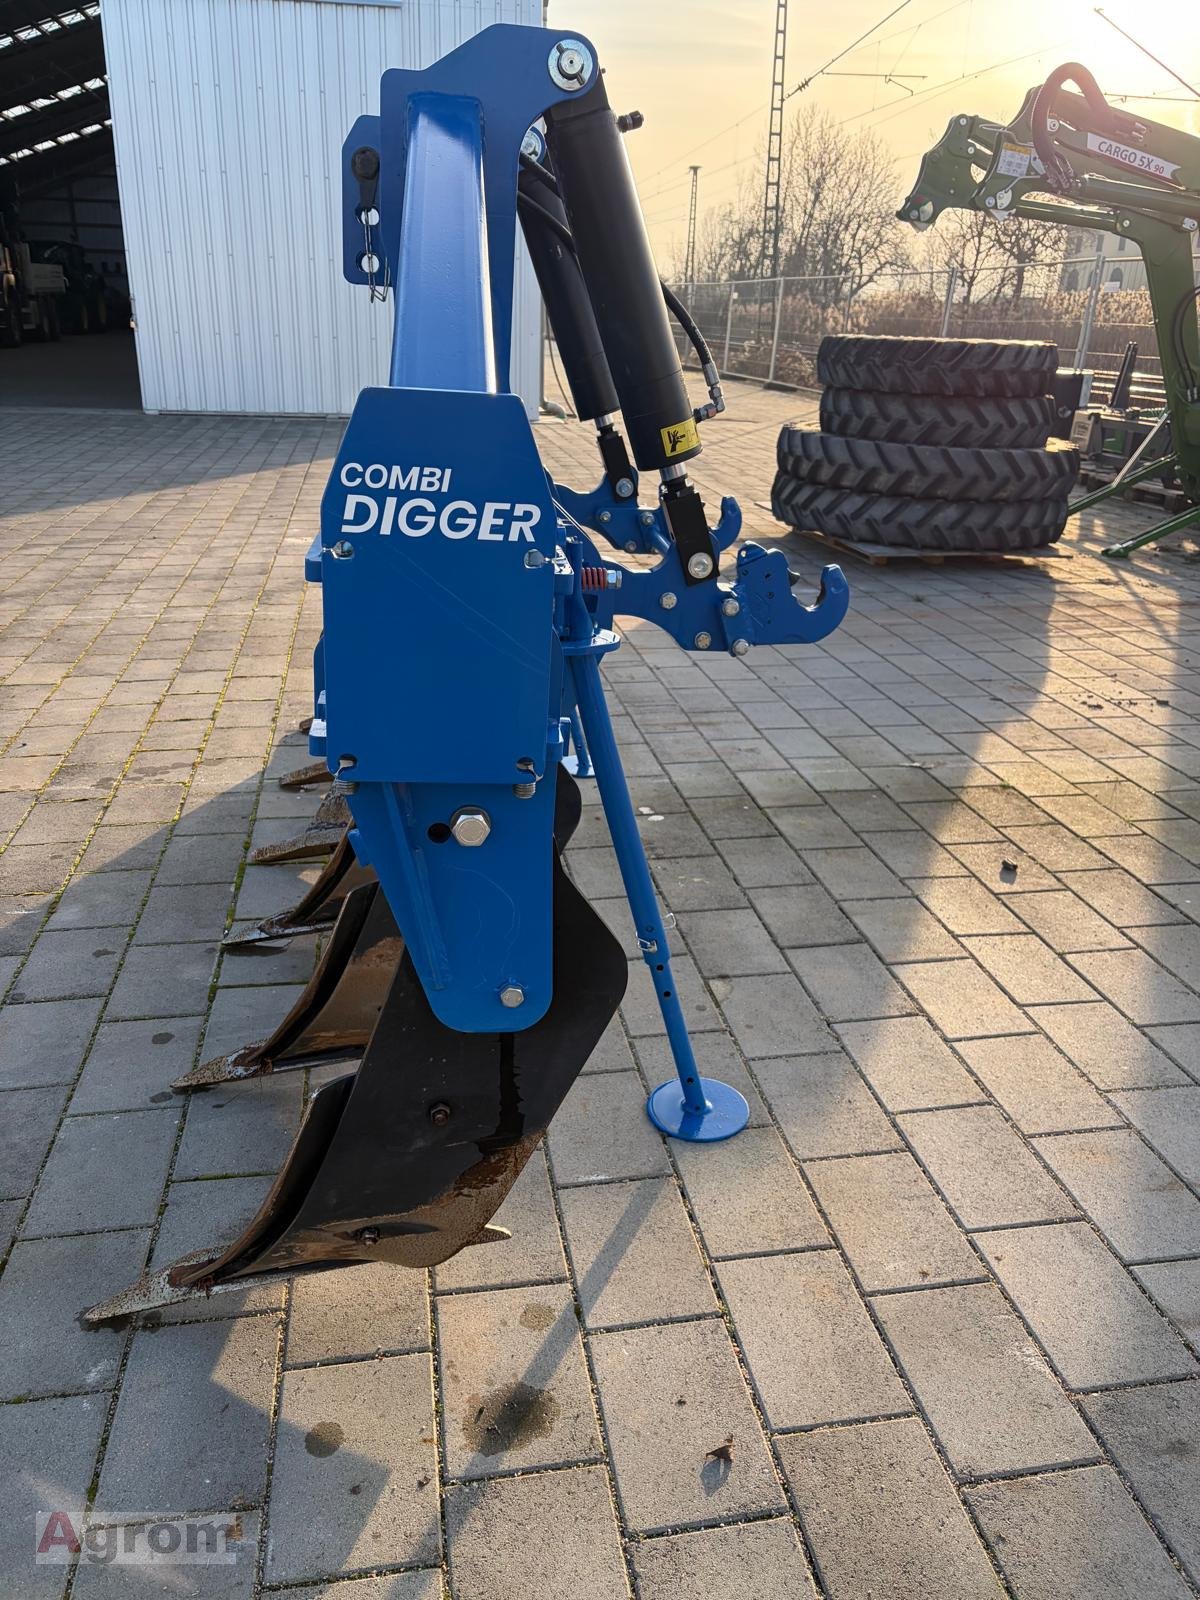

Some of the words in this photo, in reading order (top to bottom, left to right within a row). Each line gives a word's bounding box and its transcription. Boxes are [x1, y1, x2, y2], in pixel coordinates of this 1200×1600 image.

[1098, 141, 1137, 164] CARGO
[1138, 155, 1154, 171] 5X
[1153, 164, 1165, 175] 90
[340, 462, 452, 493] COMBI
[341, 494, 541, 542] DIGGER
